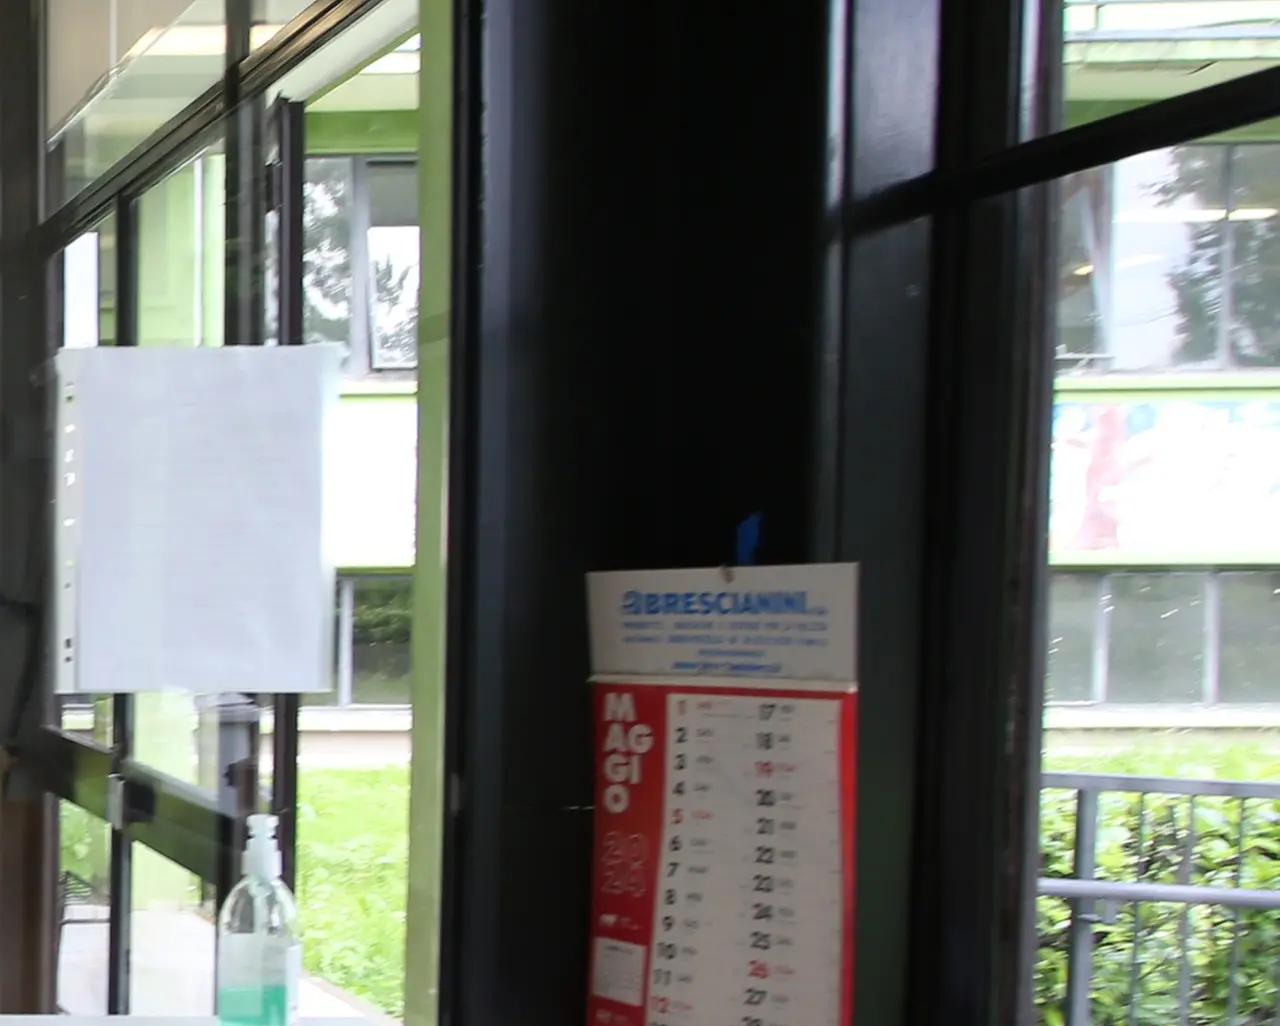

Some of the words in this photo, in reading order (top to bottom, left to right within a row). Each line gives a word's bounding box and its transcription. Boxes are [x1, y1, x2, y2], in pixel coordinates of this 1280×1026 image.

[645, 590, 808, 615] BRESCIANINI
[759, 703, 777, 720] 17
[676, 727, 688, 743] 2
[675, 754, 687, 770] 3
[672, 781, 686, 796] 4
[755, 789, 776, 806] 20
[672, 809, 684, 824] 5
[756, 817, 775, 835] 21
[669, 835, 682, 852] 6
[755, 846, 776, 863] 22
[666, 862, 680, 877] 7
[753, 874, 774, 892] 23
[753, 903, 774, 920] 24
[663, 915, 675, 931] 9
[751, 931, 772, 950] 25
[653, 969, 671, 985] 11
[744, 988, 767, 1005] 27
